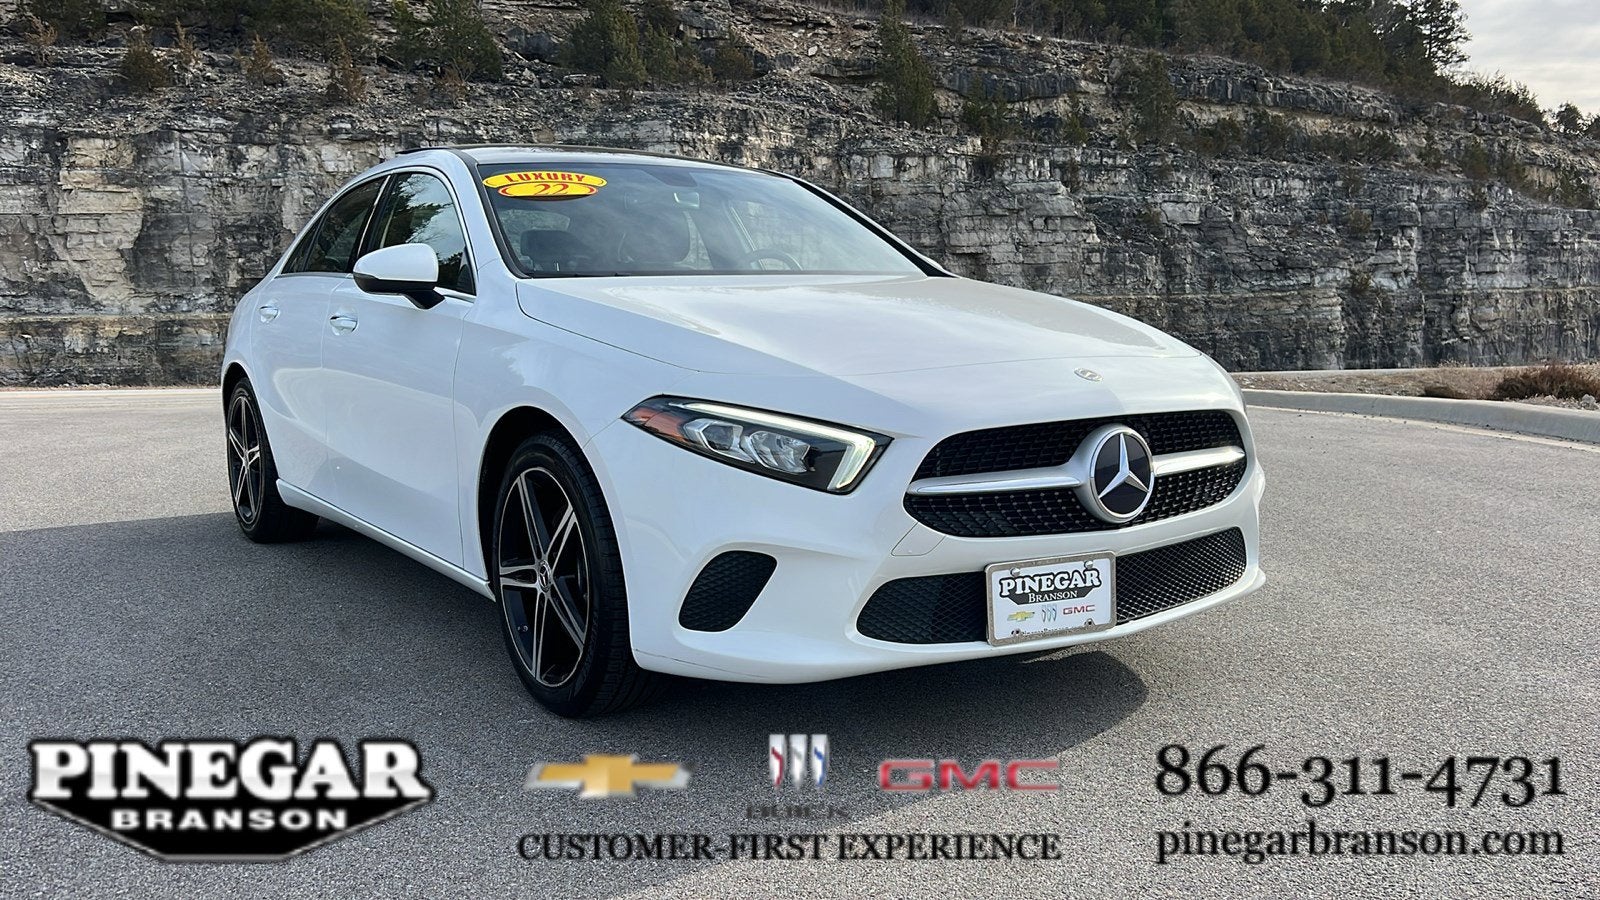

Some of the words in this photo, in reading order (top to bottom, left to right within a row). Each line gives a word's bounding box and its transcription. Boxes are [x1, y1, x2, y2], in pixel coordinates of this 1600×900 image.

[505, 172, 585, 183] LUXURY
[533, 183, 570, 196] 22
[1000, 569, 1101, 597] PINEGAR
[1028, 591, 1078, 603] BRANSON
[1063, 604, 1096, 615] GMC
